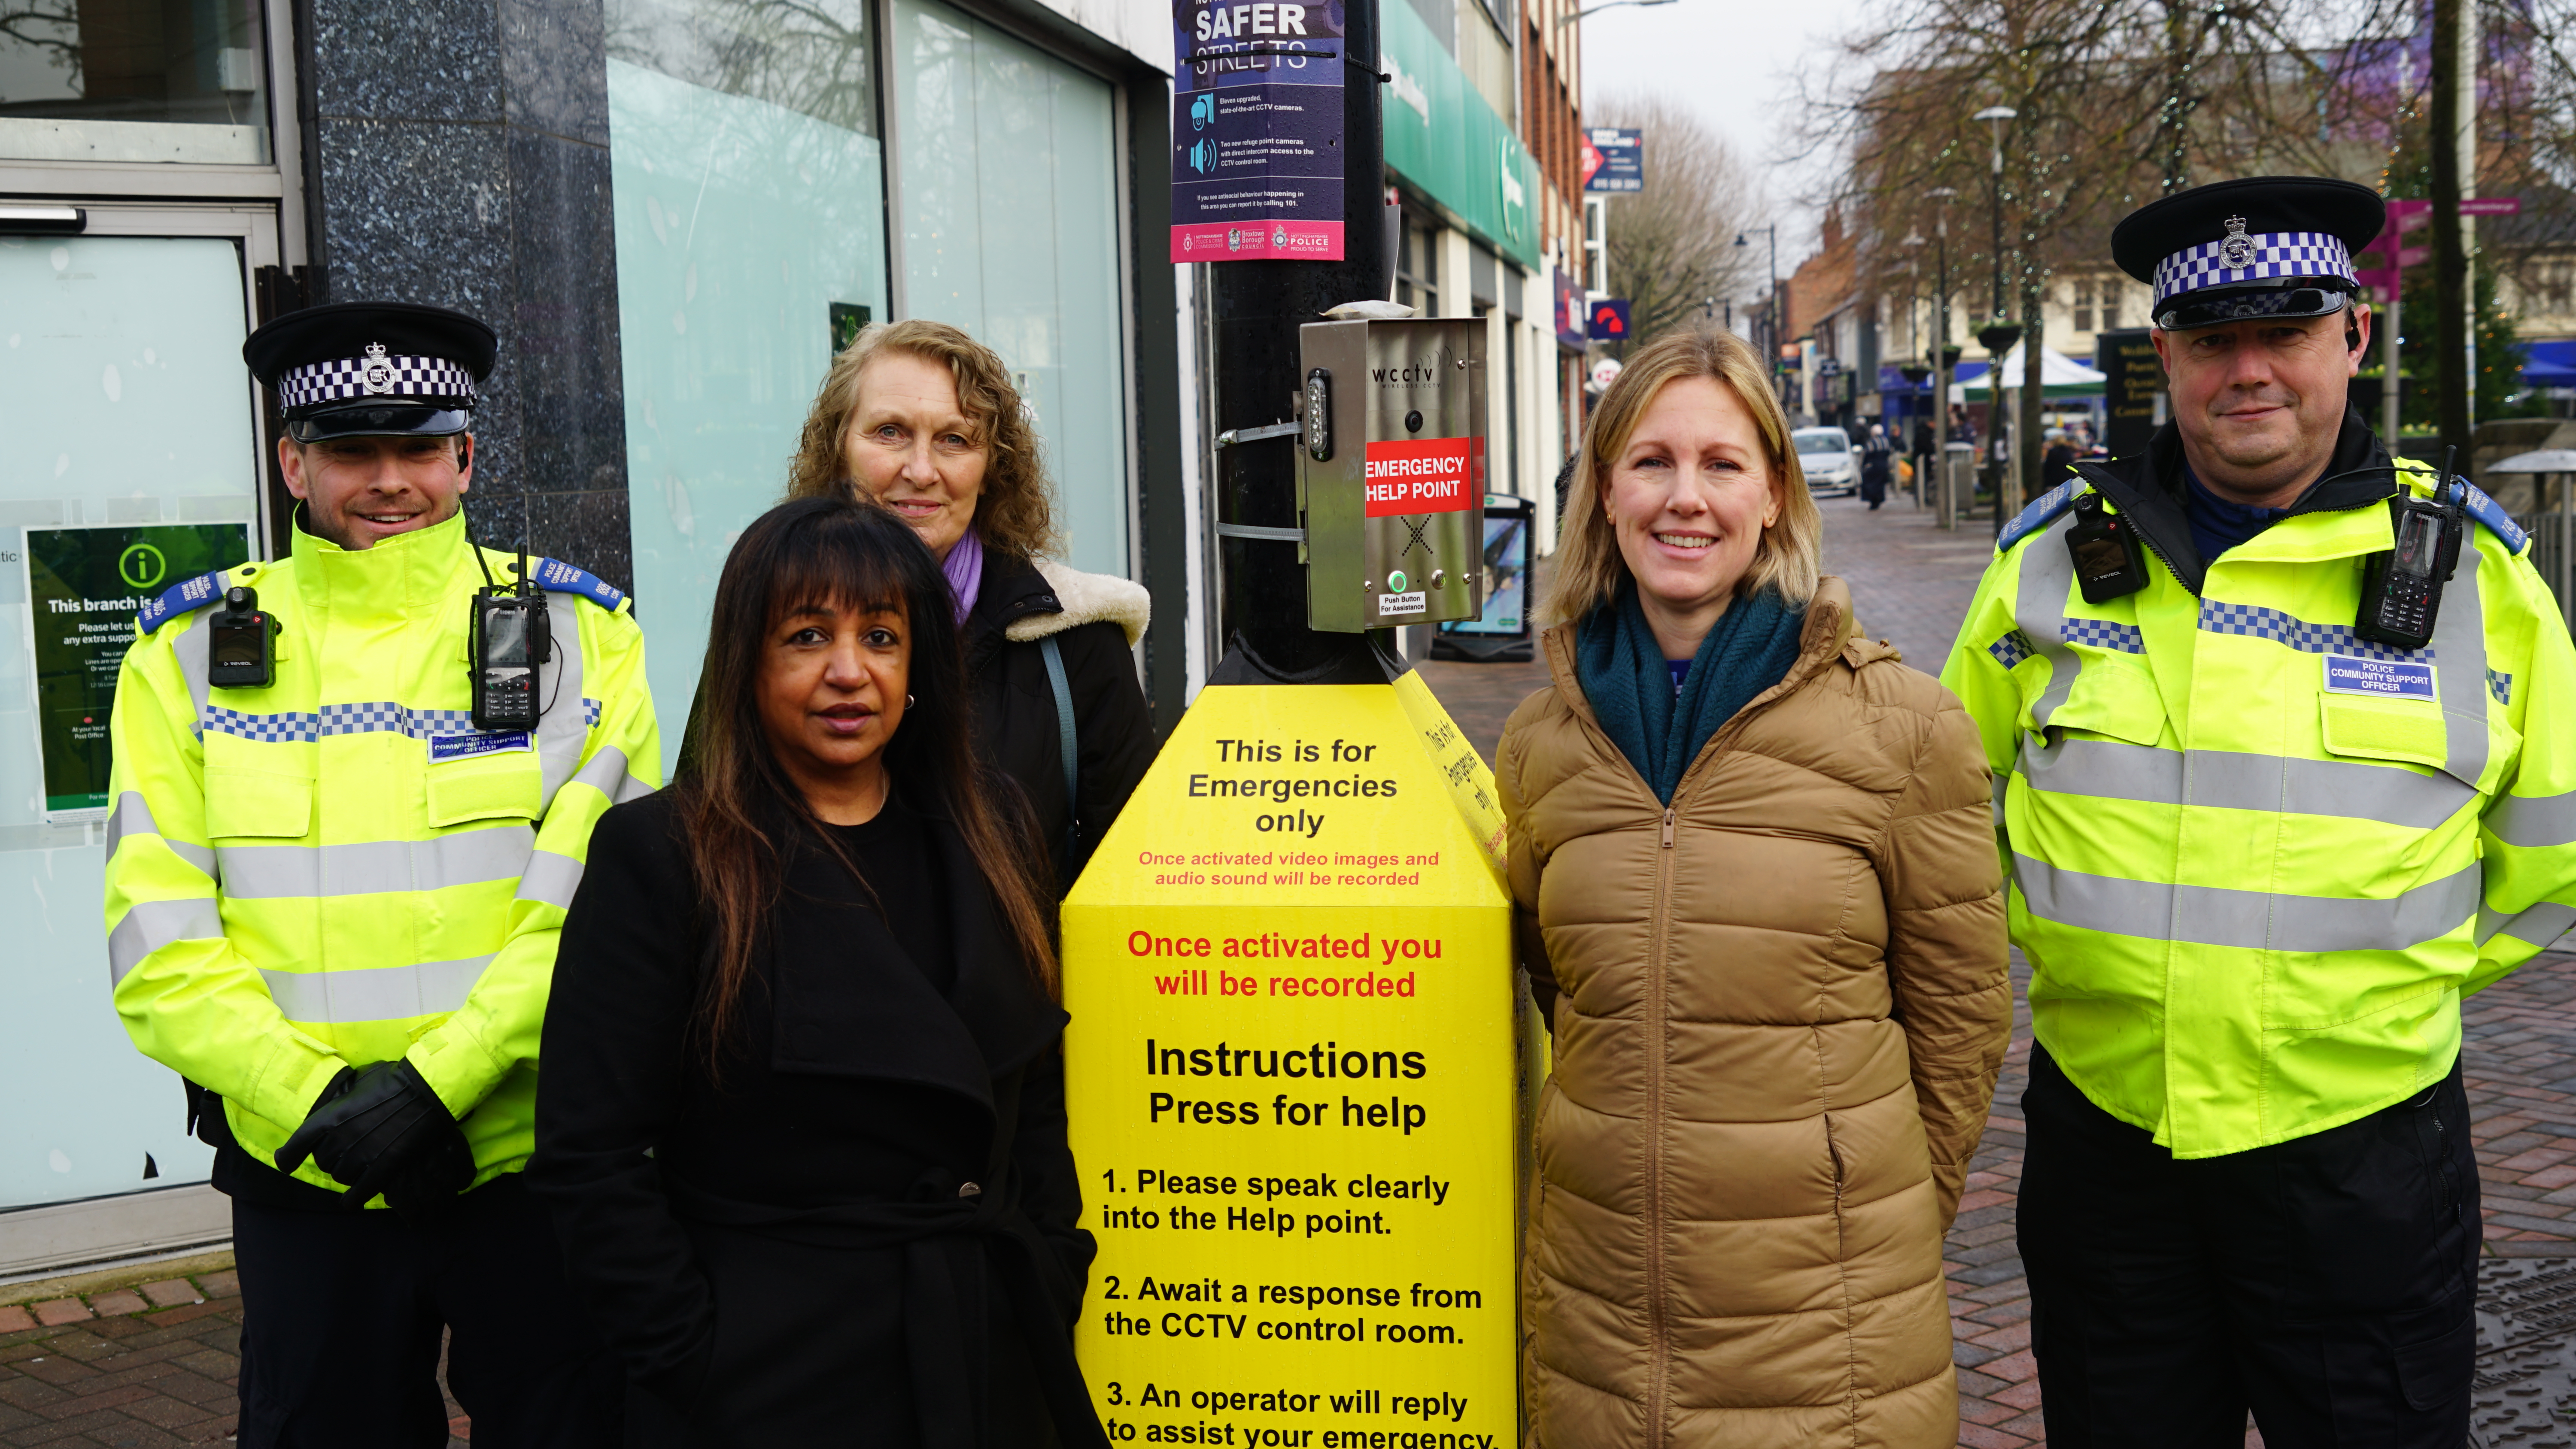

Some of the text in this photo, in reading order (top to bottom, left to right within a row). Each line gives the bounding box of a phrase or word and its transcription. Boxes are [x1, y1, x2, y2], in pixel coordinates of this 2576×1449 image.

[1196, 3, 1307, 41] SAFER
[1197, 40, 1307, 75] STREETS
[1236, 94, 1261, 103] upgraded,
[1220, 105, 1255, 114] state-of-the-art
[1259, 137, 1274, 146] point
[1264, 190, 1296, 198] happening
[1372, 364, 1432, 382] wcctv
[1365, 457, 1464, 478] EMERGENCY
[1366, 480, 1460, 501] HELP POINT
[2416, 512, 2431, 521] sepura
[544, 561, 556, 578] POLICE
[560, 566, 574, 583] SUPPORT
[181, 583, 192, 601] OFFICER
[201, 575, 211, 591] POLICE
[49, 595, 152, 613] This branch is
[79, 623, 109, 633] Please
[110, 622, 123, 631] let
[64, 635, 106, 646] any extra
[2331, 668, 2429, 685] COMMUNITY SUPPORT
[2363, 663, 2395, 674] POLICE
[2362, 680, 2400, 691] OFFICER
[434, 736, 526, 750] COMMUNITY SUPPORT
[1425, 728, 1445, 753] This
[1440, 719, 1456, 738] for
[464, 745, 496, 753] OFFICER
[1217, 740, 1376, 761] This is for
[1443, 748, 1478, 788] Emergencies
[1190, 775, 1396, 802] Emergencies
[1475, 785, 1494, 810] only
[1257, 809, 1324, 837] only
[1139, 852, 1438, 868] Once activated video images and
[1156, 872, 1419, 885] audio sound will be recorded
[1128, 931, 1441, 965] Once activated you
[1154, 970, 1414, 997] will be recorded
[1148, 1040, 1426, 1079] Instructions
[1151, 1093, 1425, 1135] Press for help
[1103, 1169, 1449, 1205] 1. Please speak clearly
[1104, 1205, 1390, 1238] into the Help point.
[1105, 1276, 1481, 1310] 2. Await a response from
[1105, 1312, 1463, 1343] the CCTV control room.
[1108, 1382, 1467, 1422] 3. An operator will reply
[1106, 1417, 1136, 1442] to
[1147, 1421, 1234, 1445] assist
[1244, 1429, 1313, 1449] your
